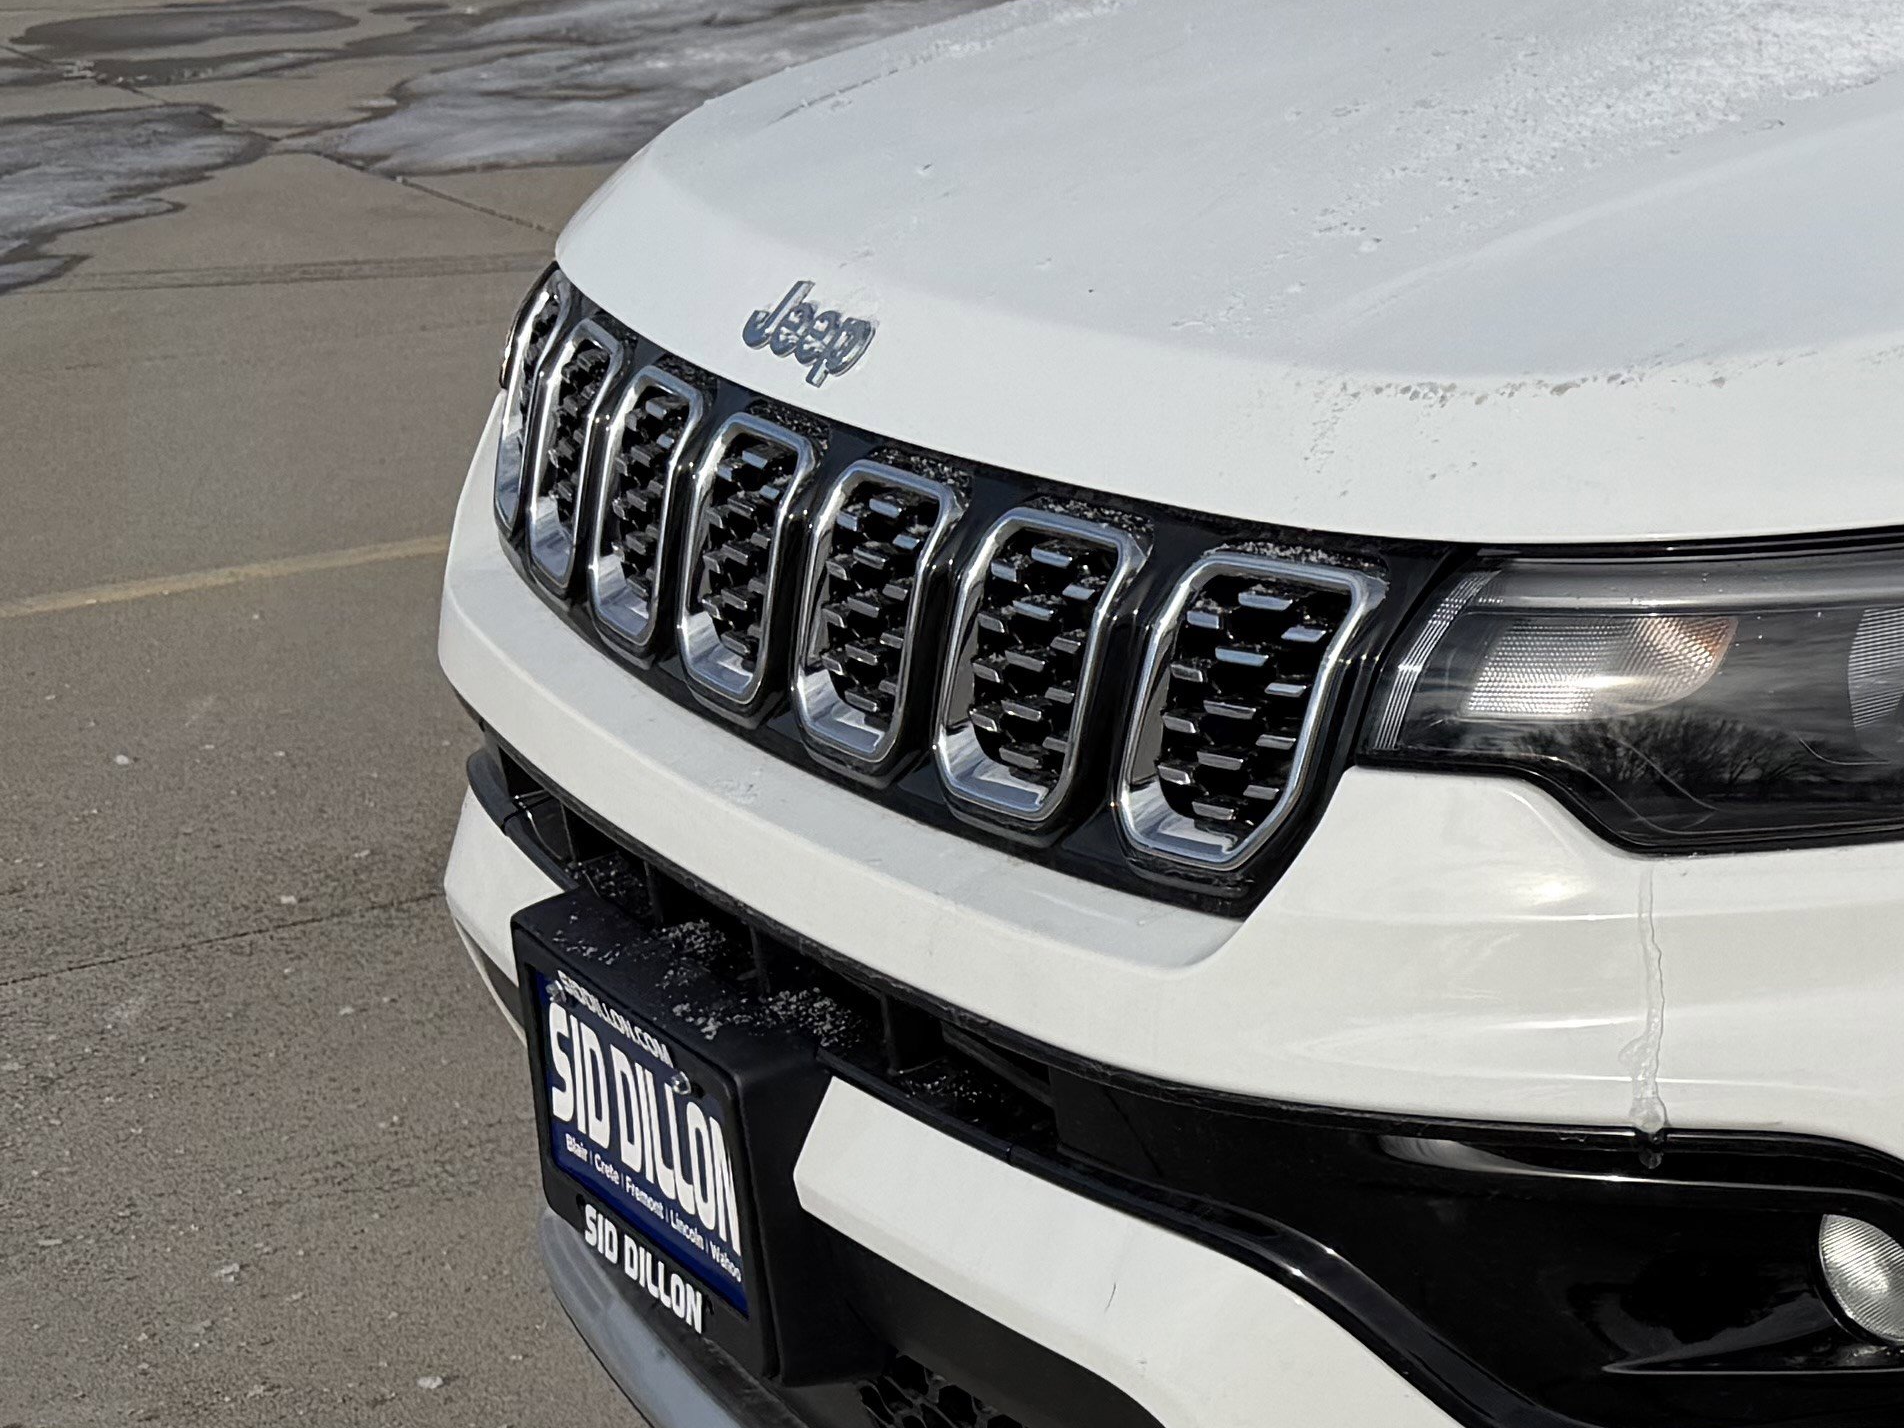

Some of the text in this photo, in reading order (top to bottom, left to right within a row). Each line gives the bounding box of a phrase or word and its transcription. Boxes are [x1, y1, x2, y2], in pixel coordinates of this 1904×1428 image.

[742, 281, 877, 388] Jeep
[549, 1002, 741, 1256] SID DILLON
[565, 1133, 741, 1283] Blair Crete Fremont Lincoln Wahoo
[584, 1203, 703, 1335] SID DILLON
